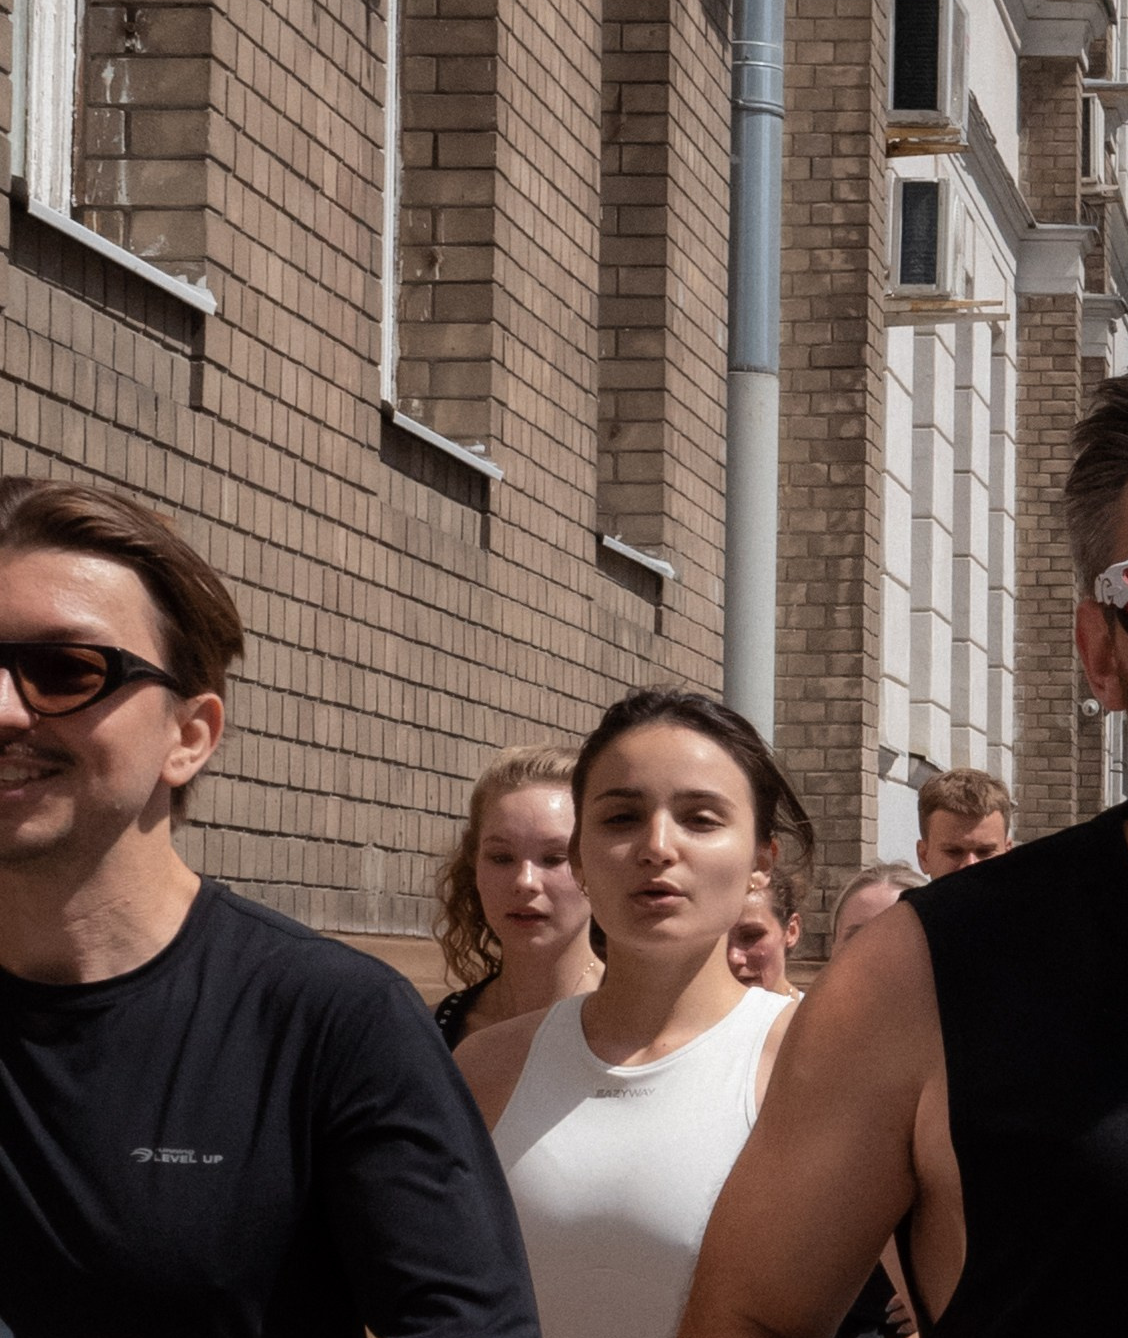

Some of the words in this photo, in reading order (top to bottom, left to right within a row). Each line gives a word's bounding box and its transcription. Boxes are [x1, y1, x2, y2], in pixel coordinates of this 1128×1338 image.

[595, 1087, 656, 1099] EAZYWAY
[154, 1152, 198, 1163] LEVEL
[203, 1154, 224, 1163] UP
